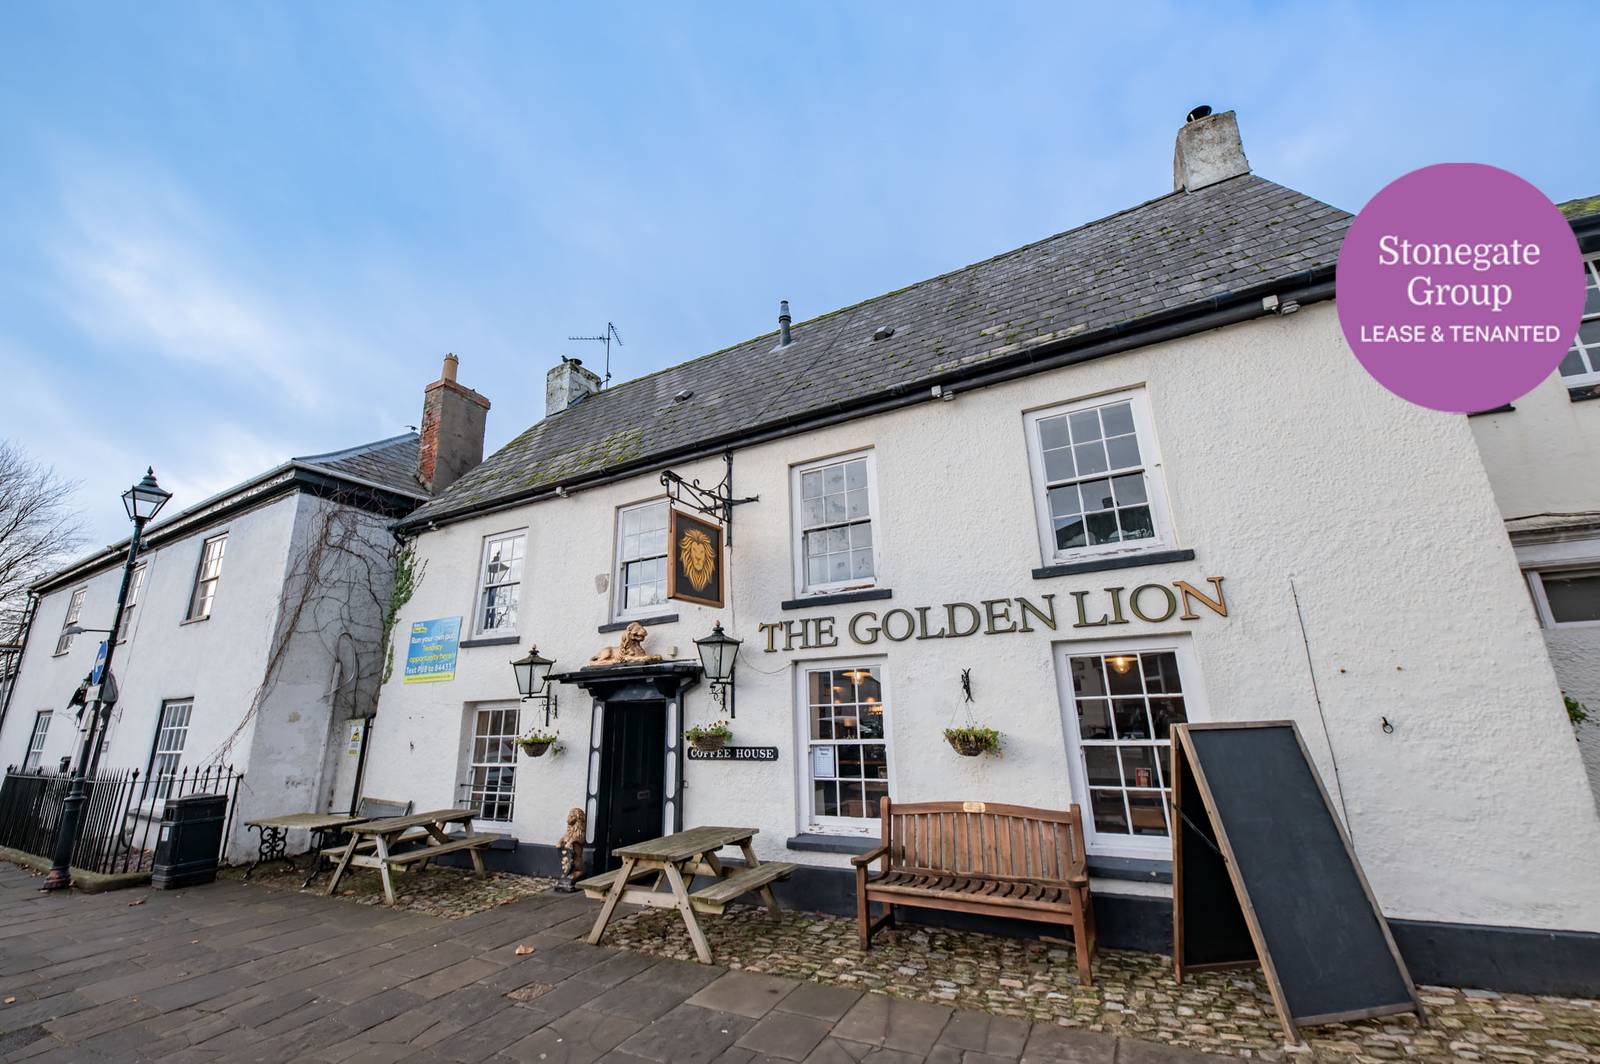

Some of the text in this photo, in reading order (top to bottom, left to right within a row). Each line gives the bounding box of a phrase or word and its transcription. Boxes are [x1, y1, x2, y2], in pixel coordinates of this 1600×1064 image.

[758, 576, 1229, 652] THE GOLDEN LION
[406, 666, 417, 674] Text
[736, 748, 774, 759] HOUSE
